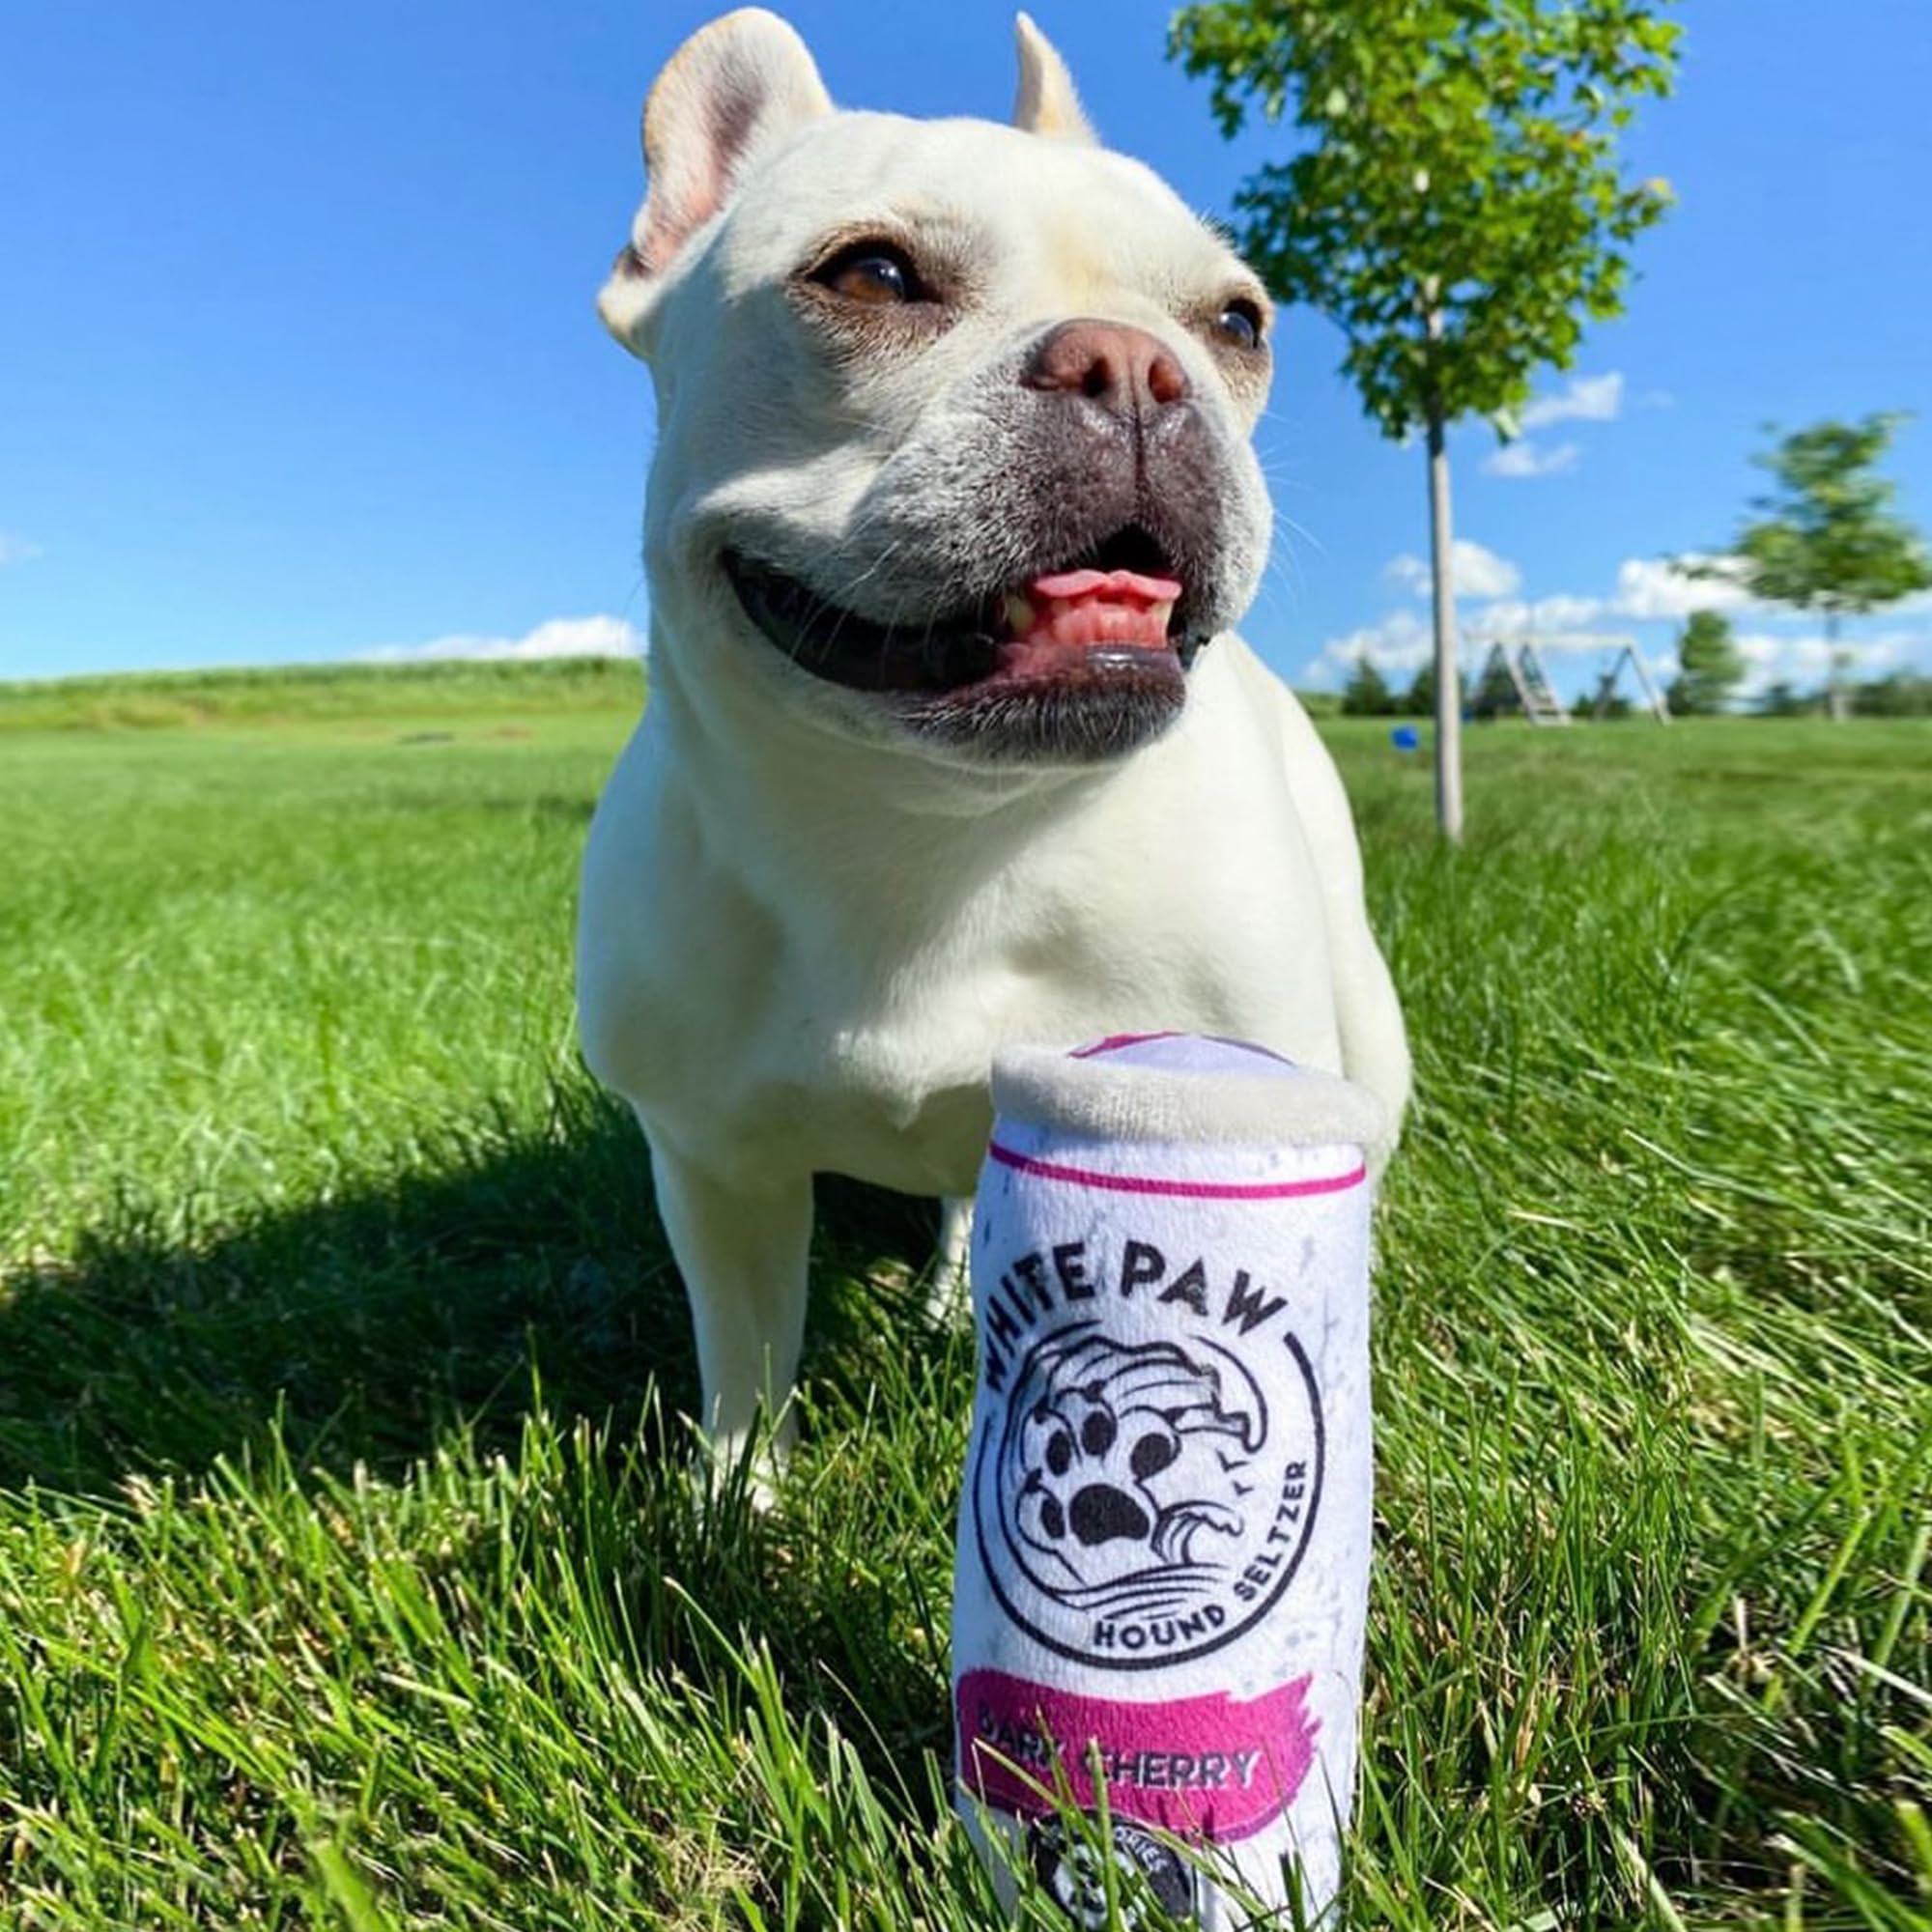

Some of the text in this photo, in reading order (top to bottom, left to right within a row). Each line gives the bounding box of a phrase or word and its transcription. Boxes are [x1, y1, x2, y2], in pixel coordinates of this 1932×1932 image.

[985, 1239, 1289, 1394] WHITE PAW
[1093, 1460, 1307, 1651] HOUND SELTZER
